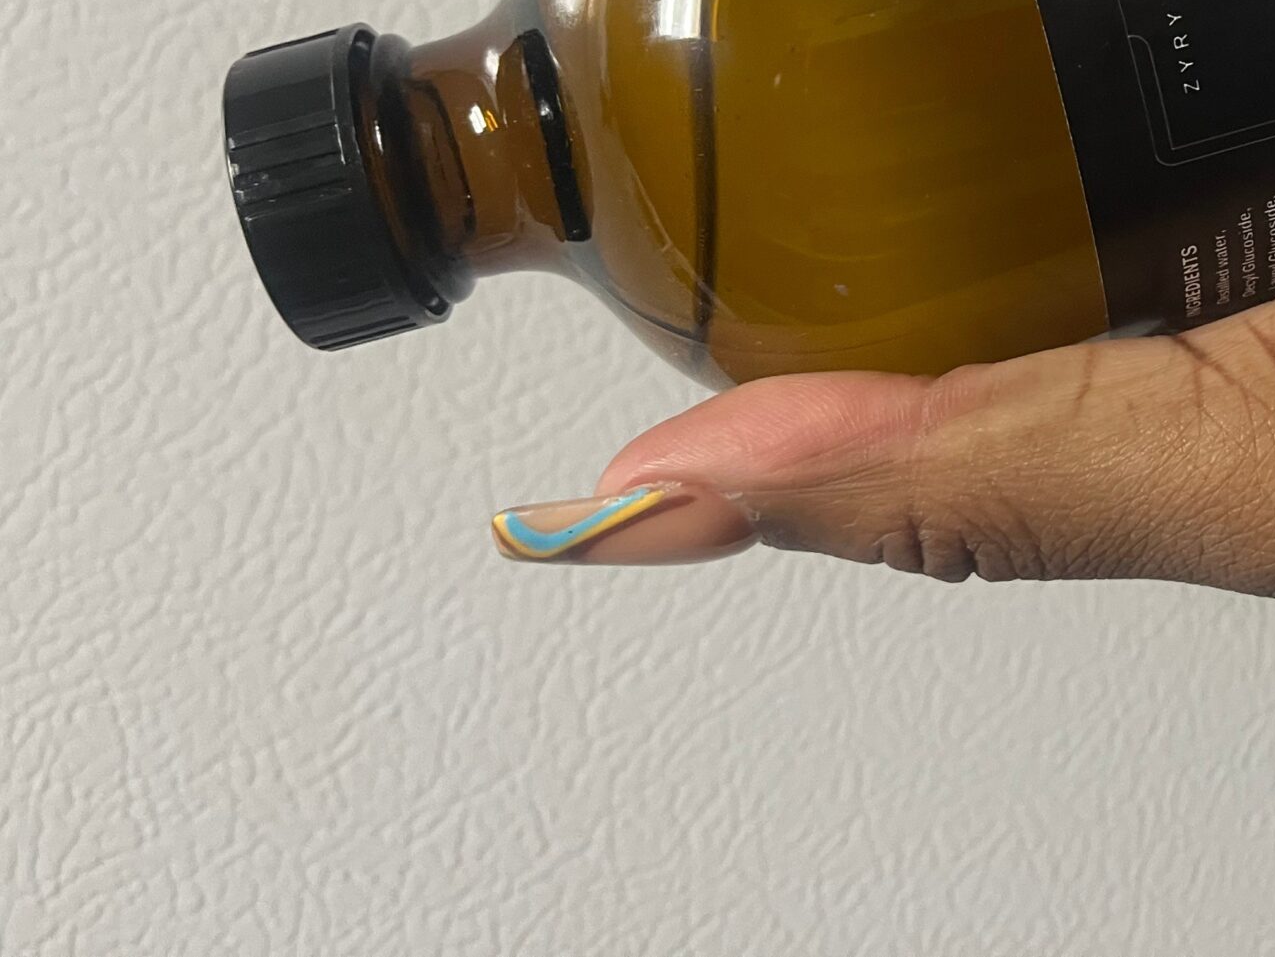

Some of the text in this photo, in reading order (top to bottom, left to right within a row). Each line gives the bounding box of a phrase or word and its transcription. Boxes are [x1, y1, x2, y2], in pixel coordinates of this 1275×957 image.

[1166, 13, 1199, 93] ZYRY
[1181, 245, 1201, 318] INGREDIENTS
[1215, 230, 1228, 269] water,
[1237, 207, 1260, 298] Decyl Glucoside,
